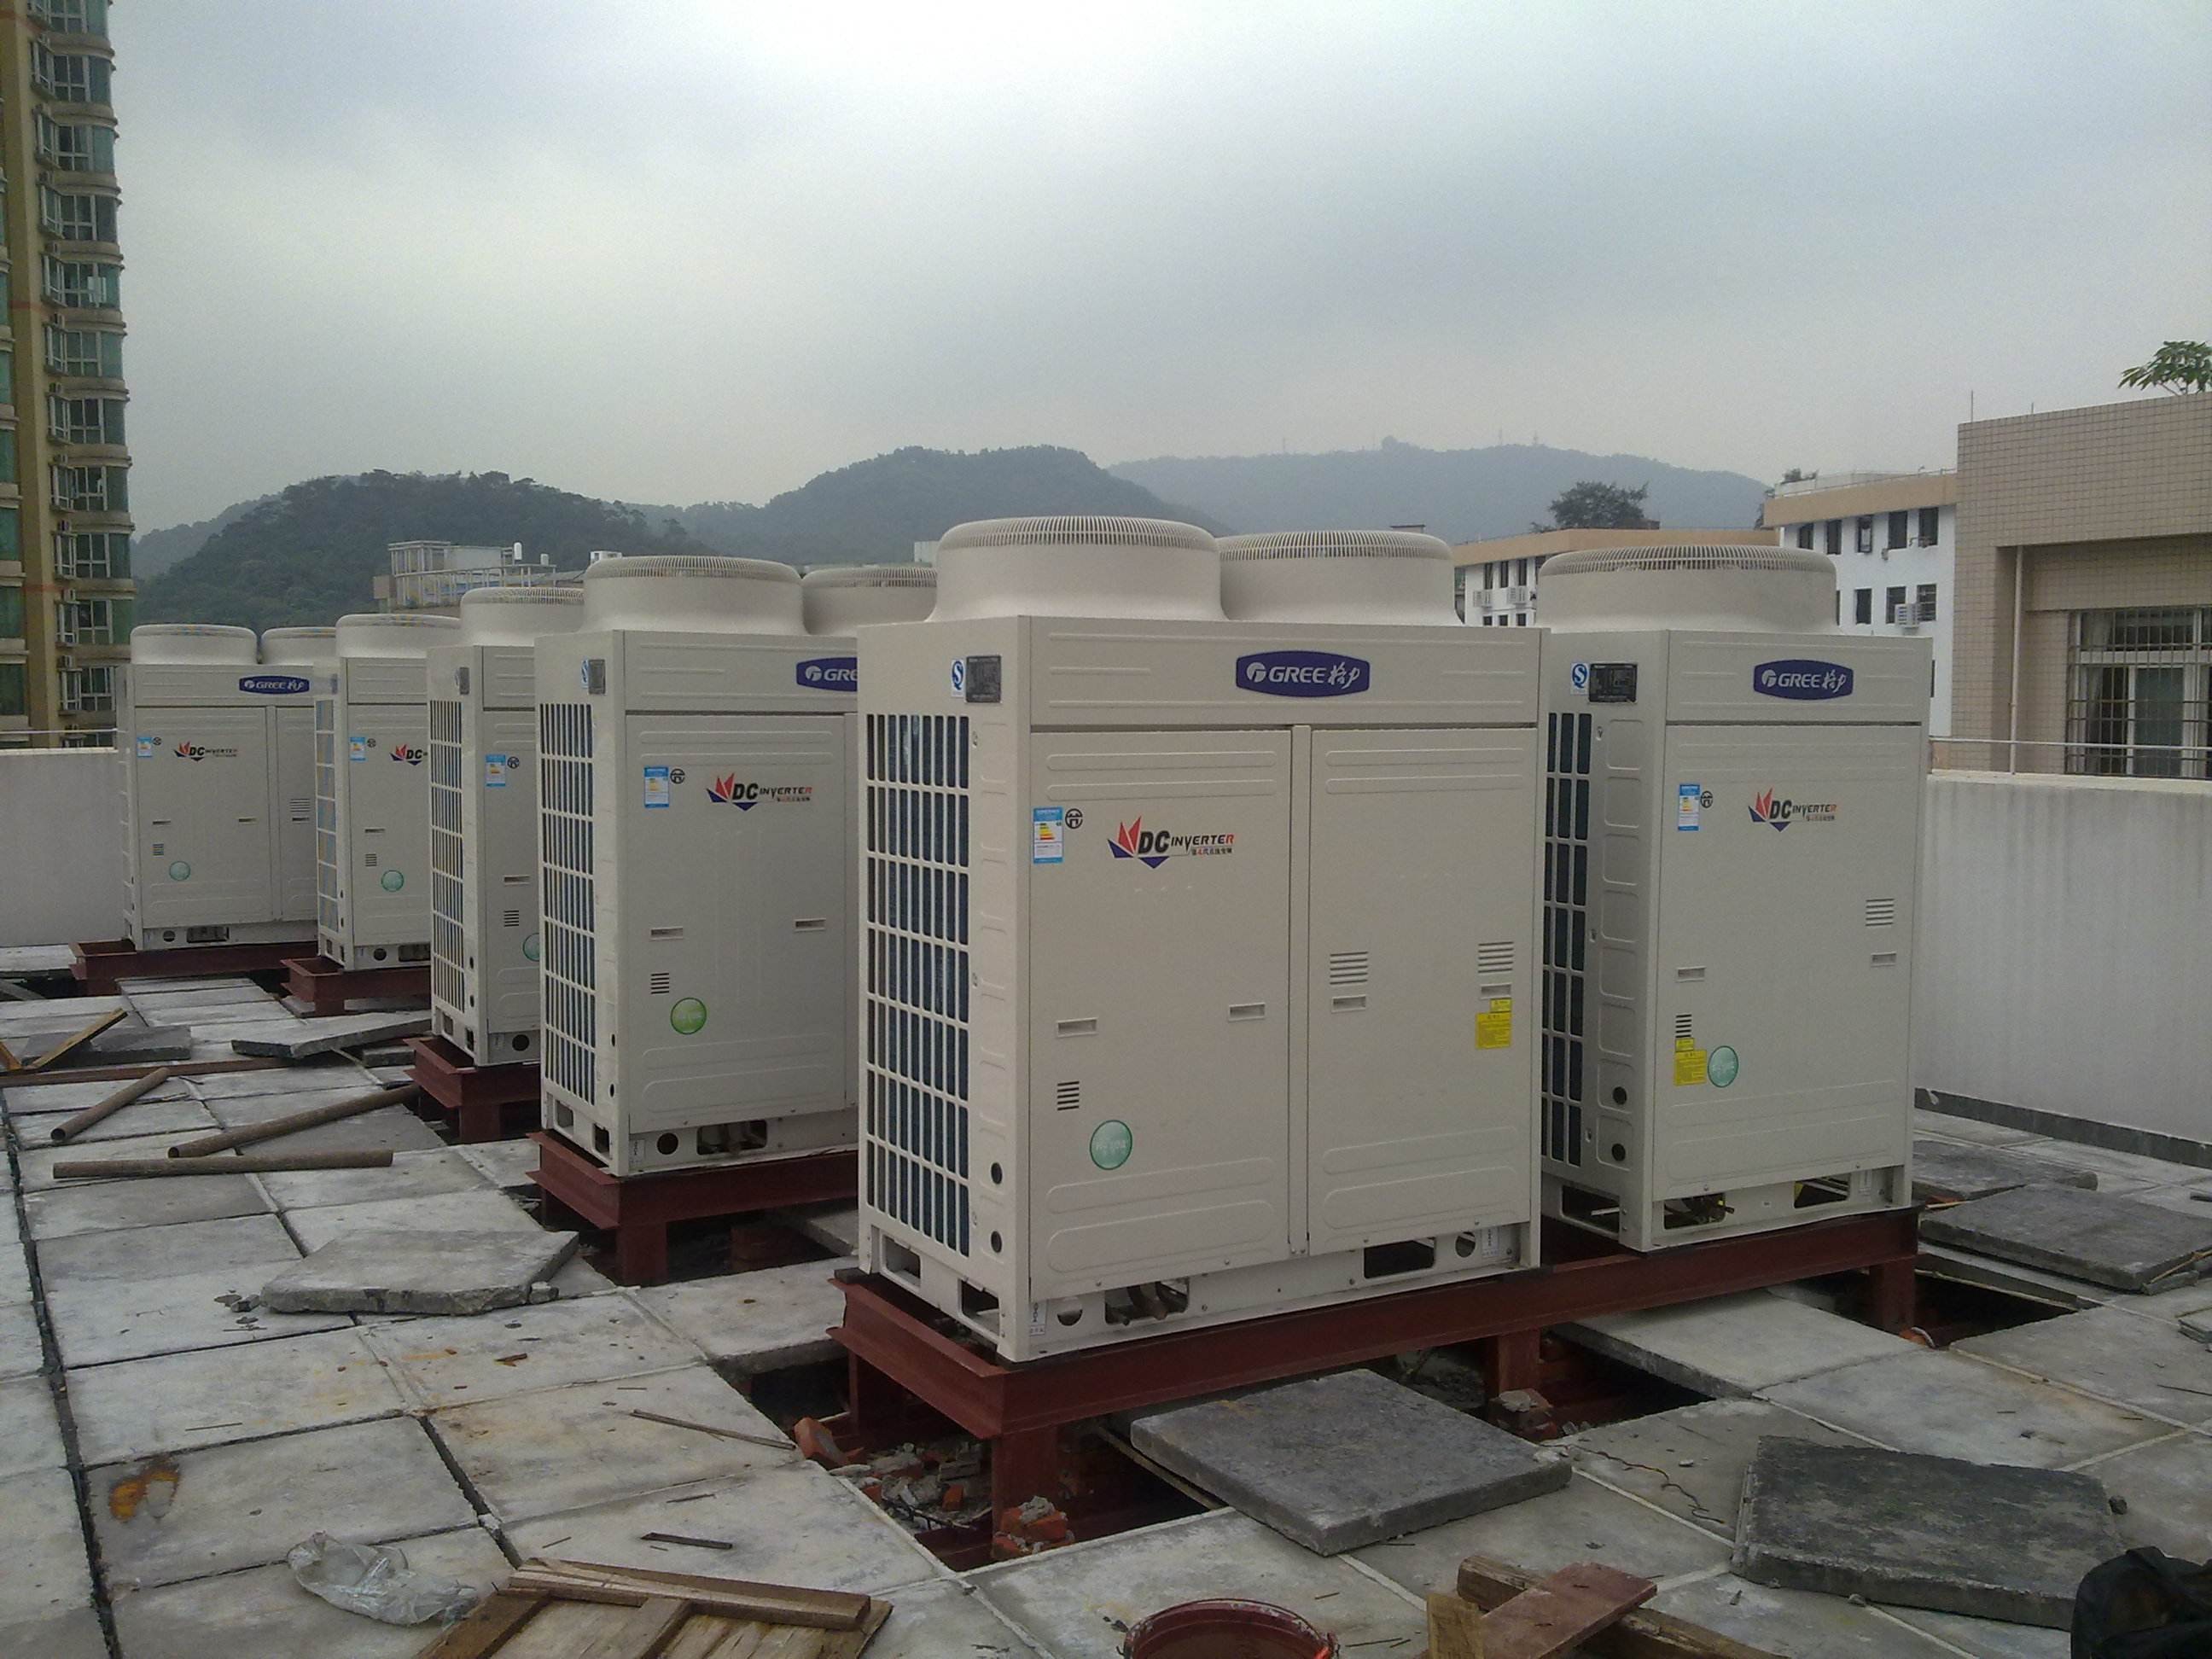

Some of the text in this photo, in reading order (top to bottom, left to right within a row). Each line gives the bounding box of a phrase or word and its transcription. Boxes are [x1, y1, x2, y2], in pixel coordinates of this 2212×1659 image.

[1268, 667, 1326, 684] GREE
[1778, 672, 1821, 688] GREE
[189, 747, 205, 756] DC
[406, 749, 423, 760] DC
[732, 783, 812, 800] DC INVERTER
[1769, 800, 1837, 819] DC INVERTER
[1138, 830, 1236, 854] DC INVERTER
